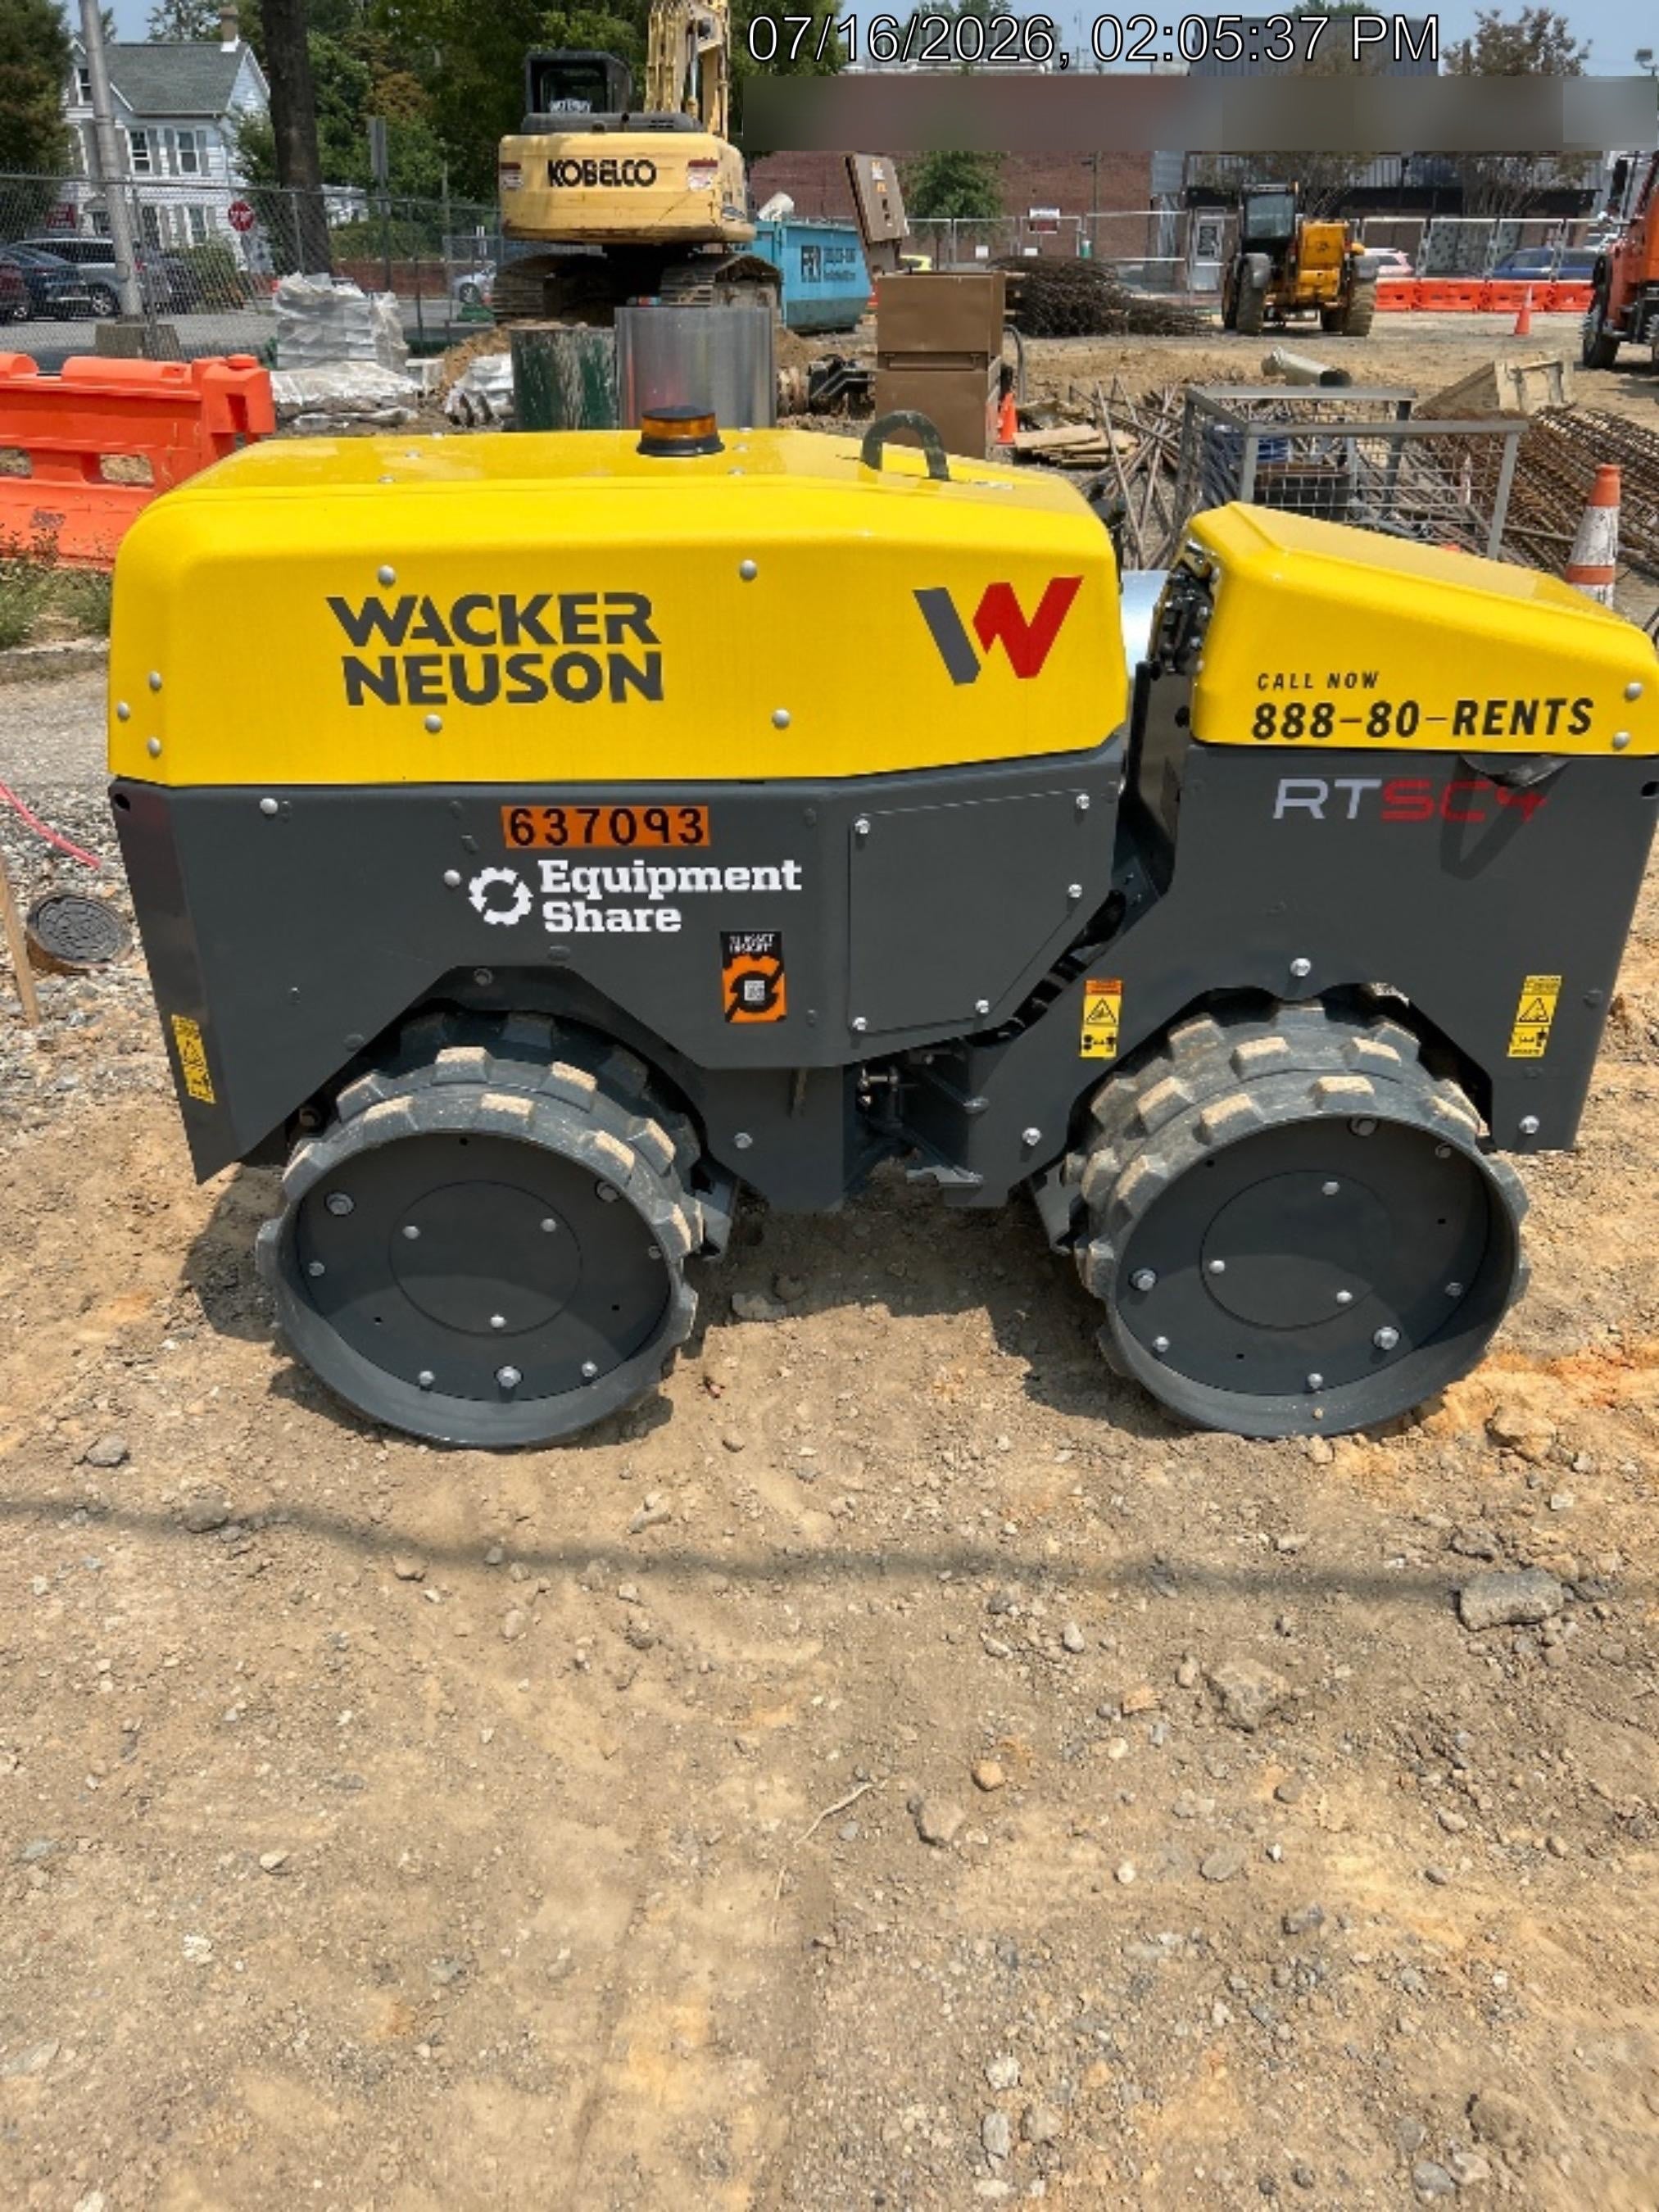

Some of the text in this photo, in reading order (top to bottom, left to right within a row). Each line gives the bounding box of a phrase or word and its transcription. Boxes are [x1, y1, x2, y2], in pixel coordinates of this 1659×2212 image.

[547, 159, 657, 188] KOBELCO
[326, 592, 661, 647] WACKER
[342, 651, 664, 707] NEUSON
[1257, 670, 1379, 691] CALL NOW
[1252, 697, 1594, 741] 888-80-RENTS
[509, 807, 705, 846] 637093
[537, 859, 803, 901] Equipment
[542, 900, 683, 933] Share
